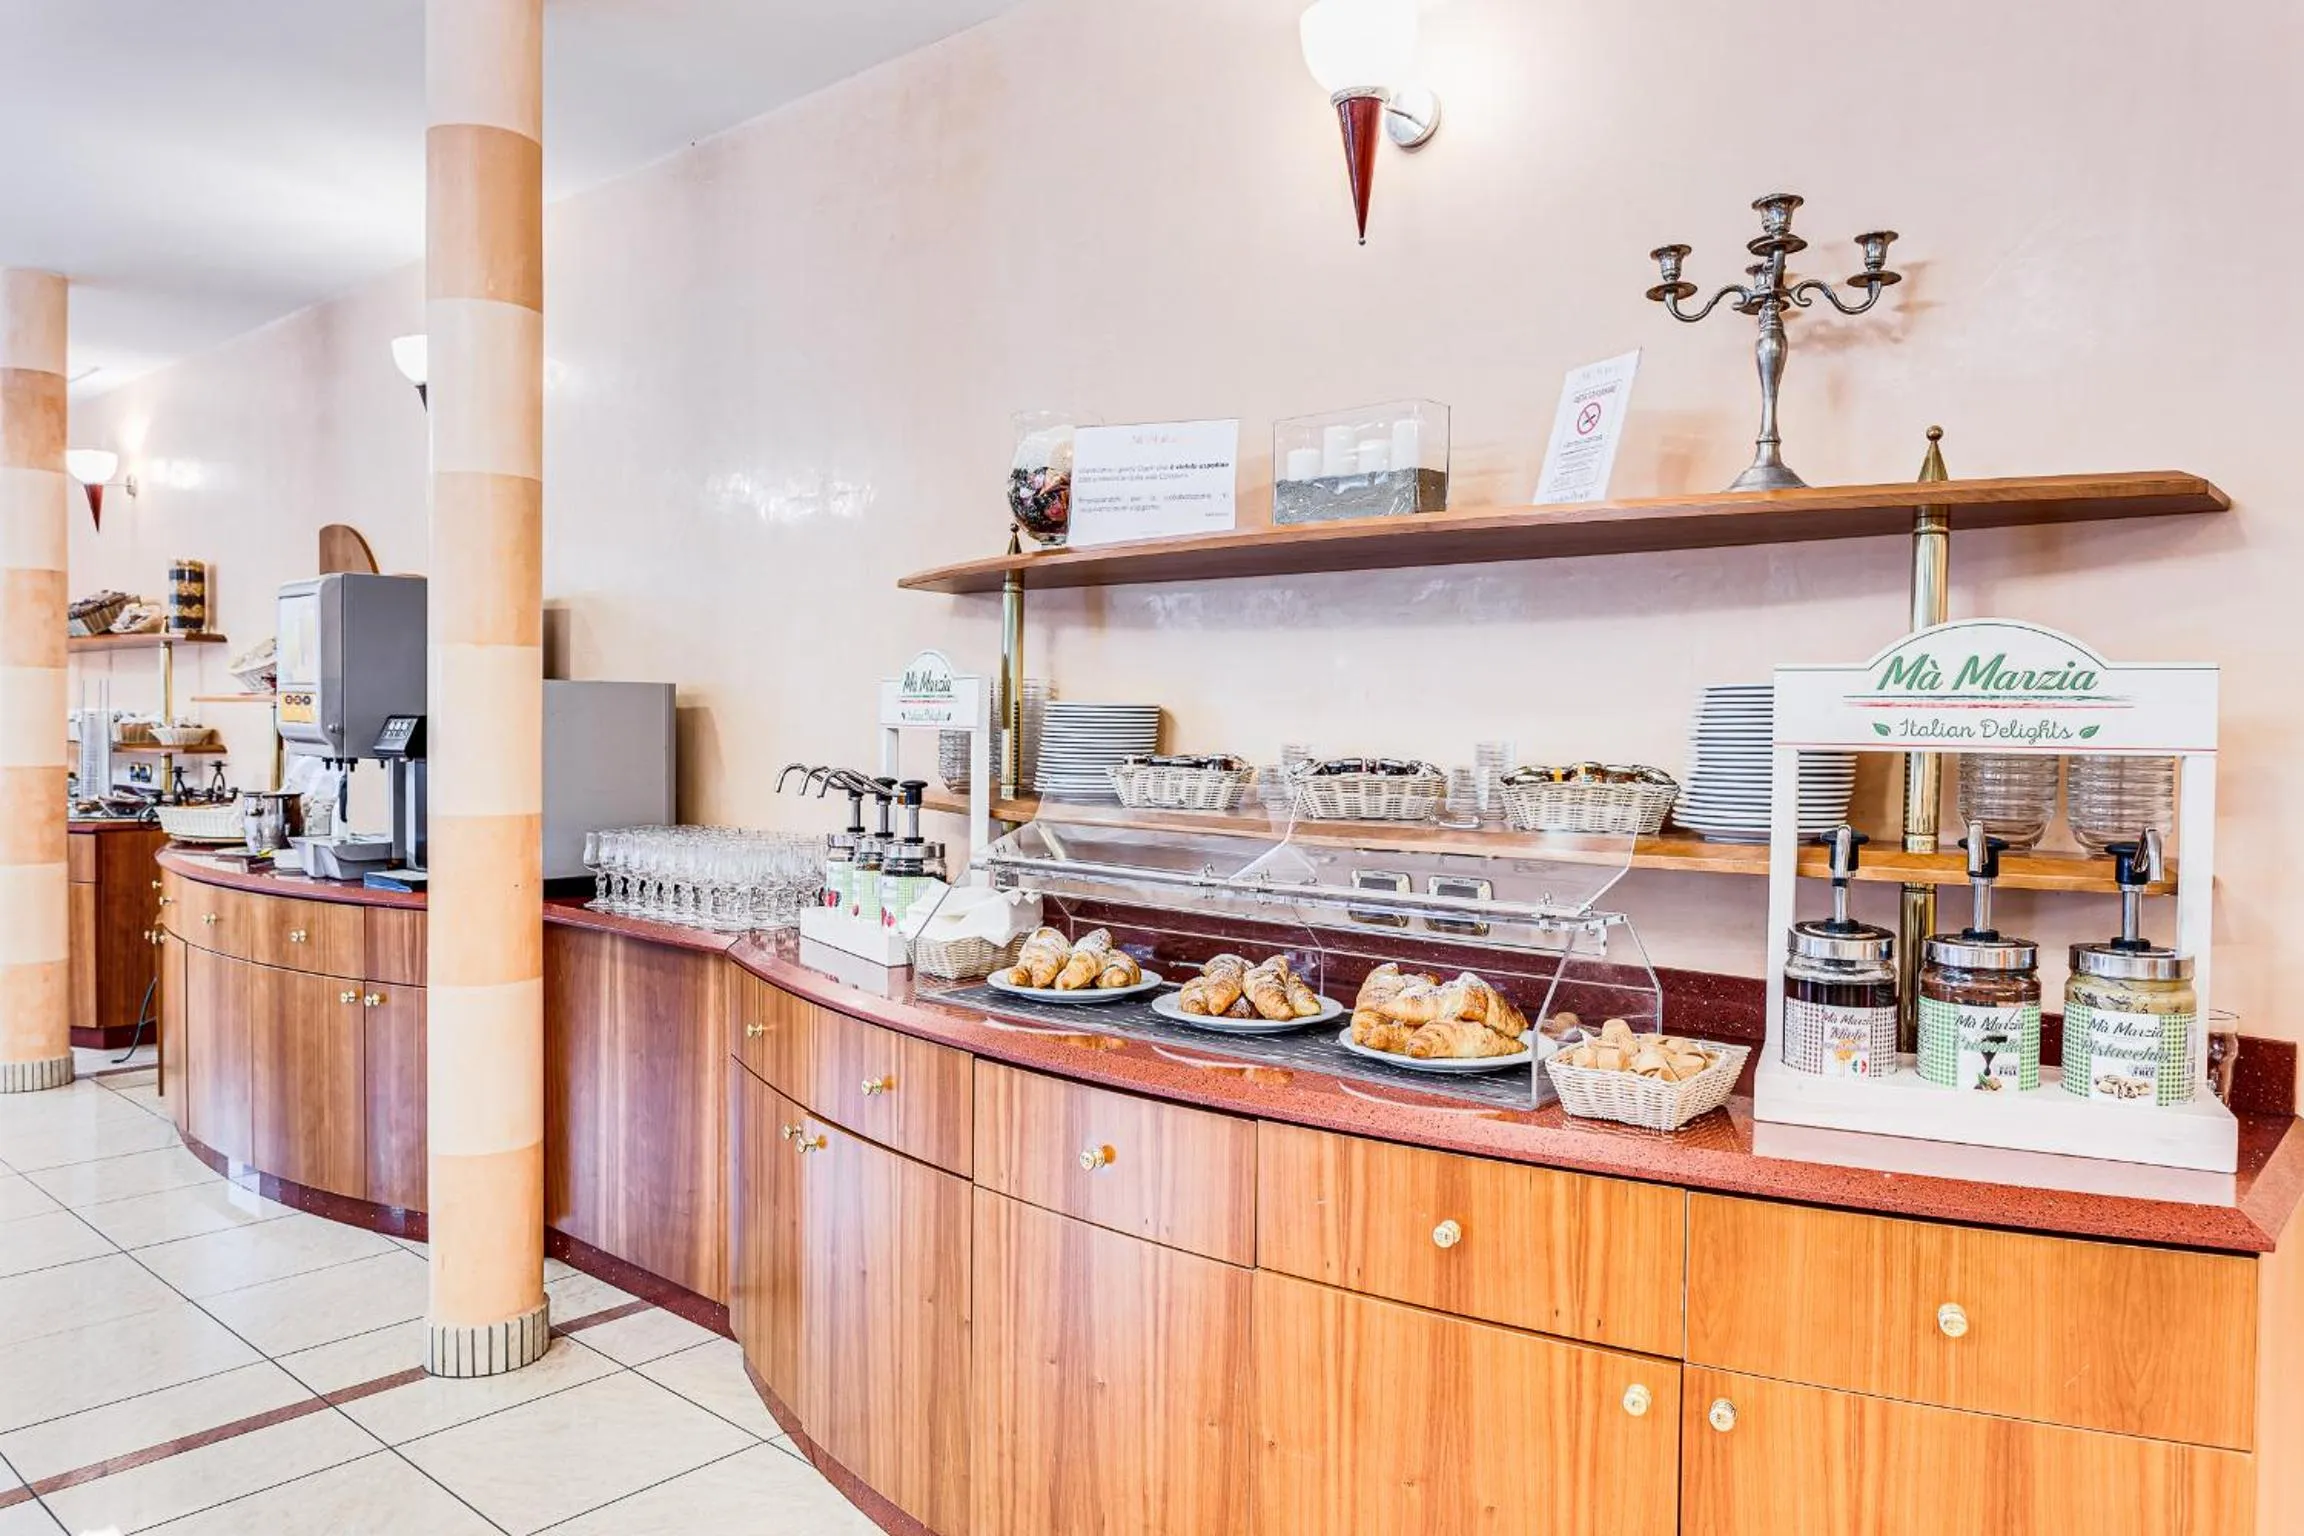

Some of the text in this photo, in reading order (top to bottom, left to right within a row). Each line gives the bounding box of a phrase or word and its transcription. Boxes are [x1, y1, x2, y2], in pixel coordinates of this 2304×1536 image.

[1876, 653, 2099, 691] Mà Marzia
[1899, 717, 2074, 744] Italian Delights
[2112, 1021, 2165, 1039] Marzia
